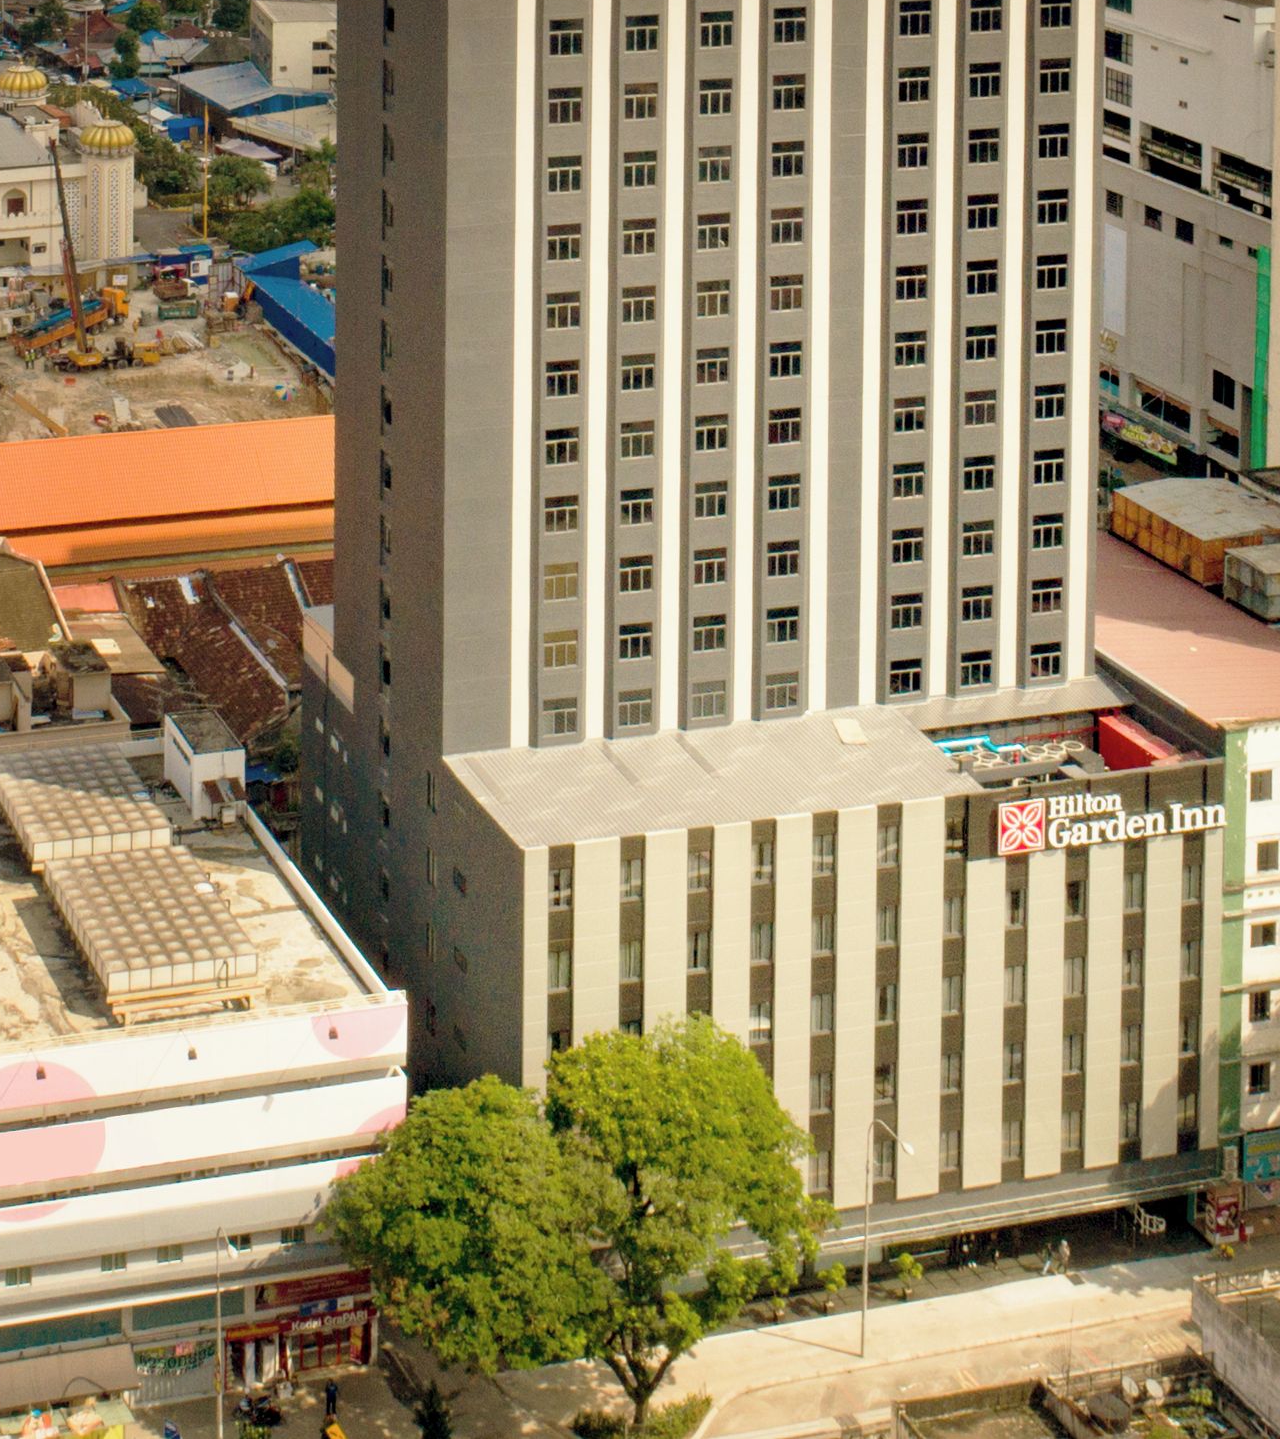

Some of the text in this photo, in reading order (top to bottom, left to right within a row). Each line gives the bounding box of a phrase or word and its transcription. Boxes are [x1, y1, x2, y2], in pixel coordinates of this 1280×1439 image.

[1048, 793, 1122, 820] Hilton
[1048, 802, 1227, 848] Garden Inn
